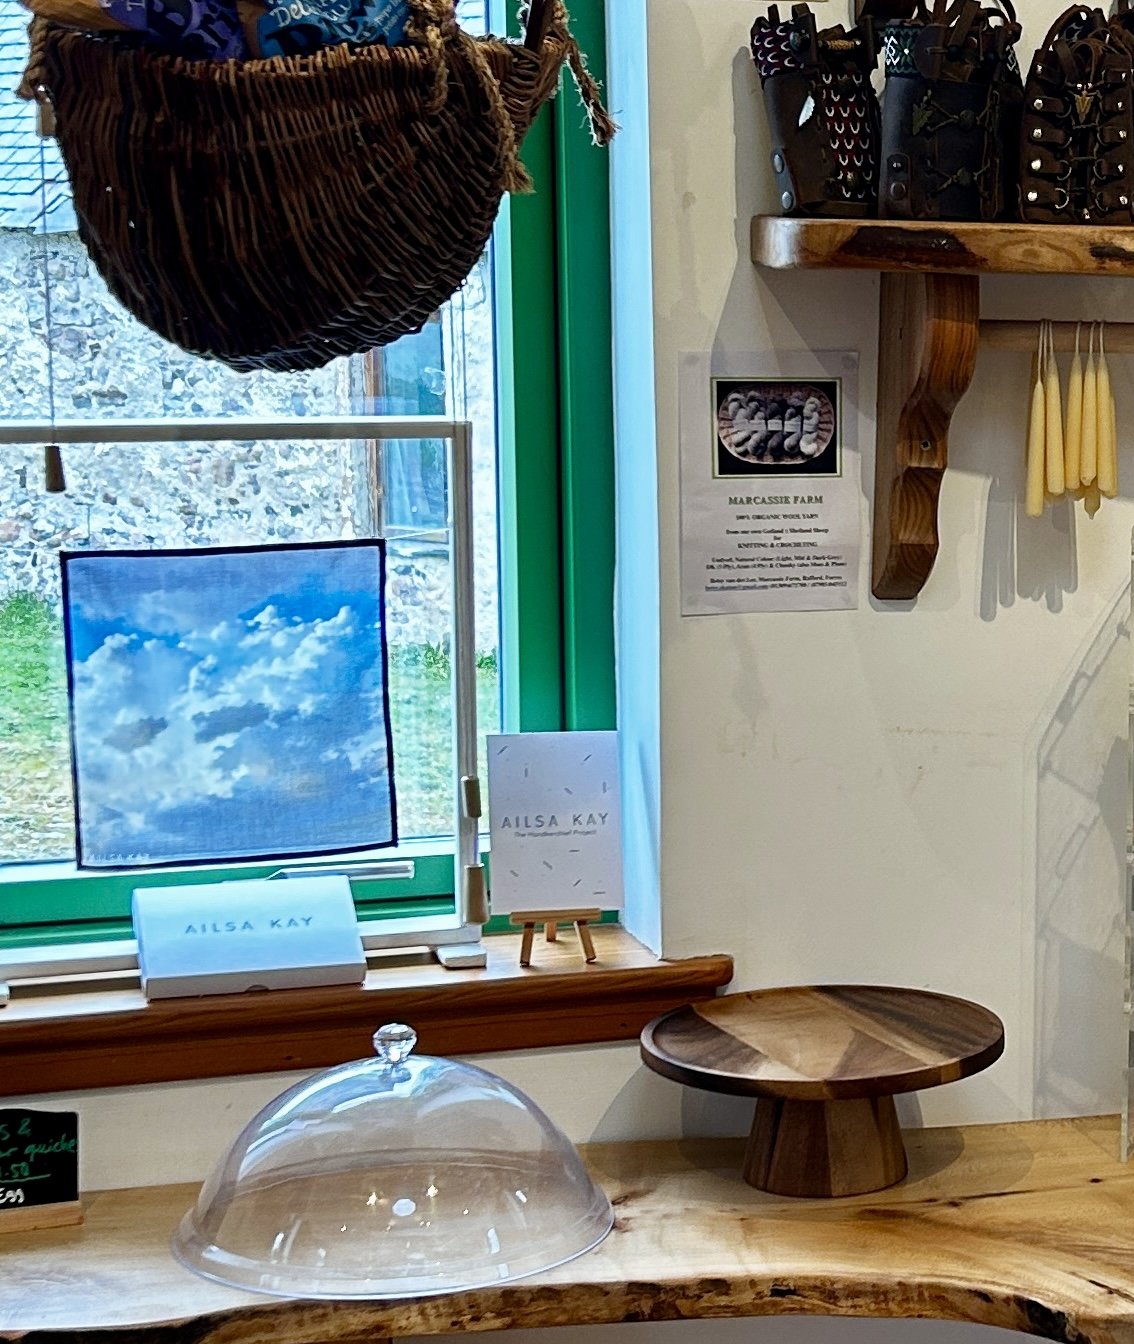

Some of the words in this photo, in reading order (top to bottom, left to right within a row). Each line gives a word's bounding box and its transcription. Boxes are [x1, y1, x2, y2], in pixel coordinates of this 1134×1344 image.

[728, 496, 790, 506] MARCASSIE
[794, 496, 824, 504] FARM
[501, 814, 558, 828] AILSA
[572, 812, 609, 826] KAY
[185, 921, 254, 934] AILSA
[270, 916, 313, 930] KAY
